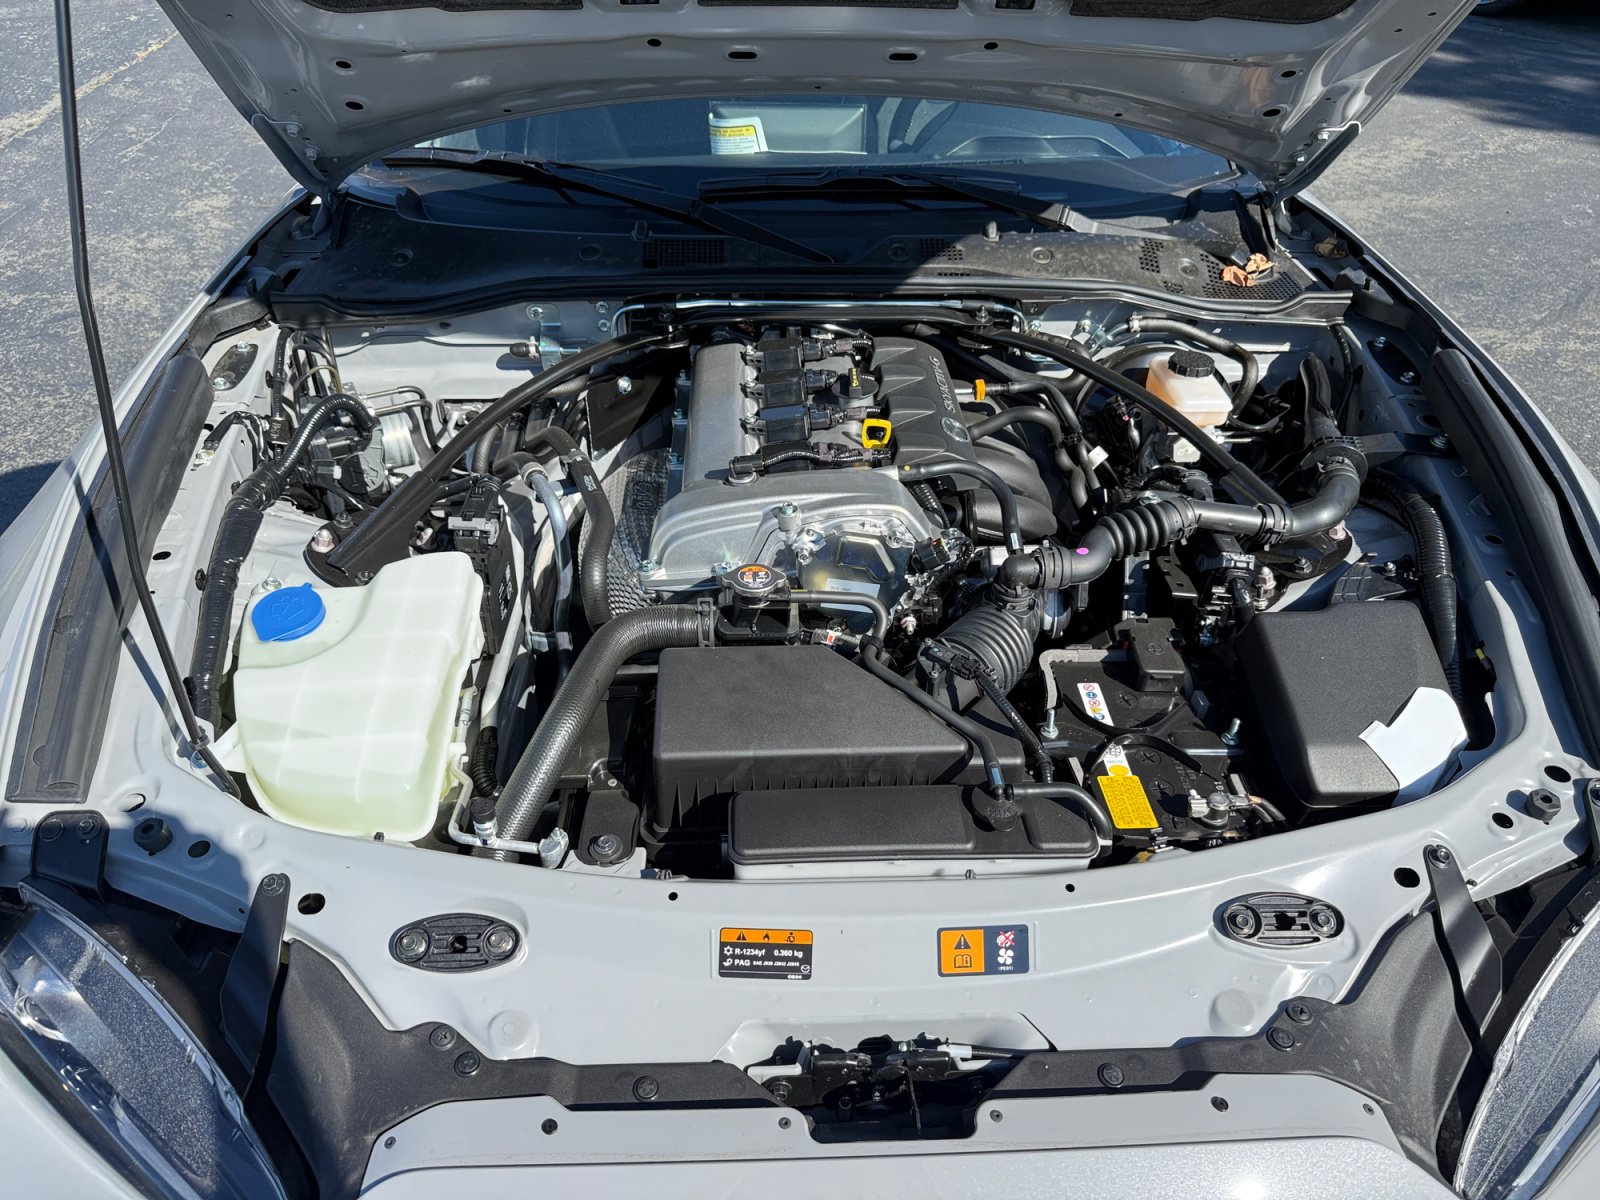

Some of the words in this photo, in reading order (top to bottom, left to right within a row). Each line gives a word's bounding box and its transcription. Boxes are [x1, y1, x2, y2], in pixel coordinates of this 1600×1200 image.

[928, 355, 956, 414] SKYACTIV-G
[734, 948, 766, 957] R-1234yf
[793, 950, 803, 959] kg
[734, 959, 751, 967] PAG
